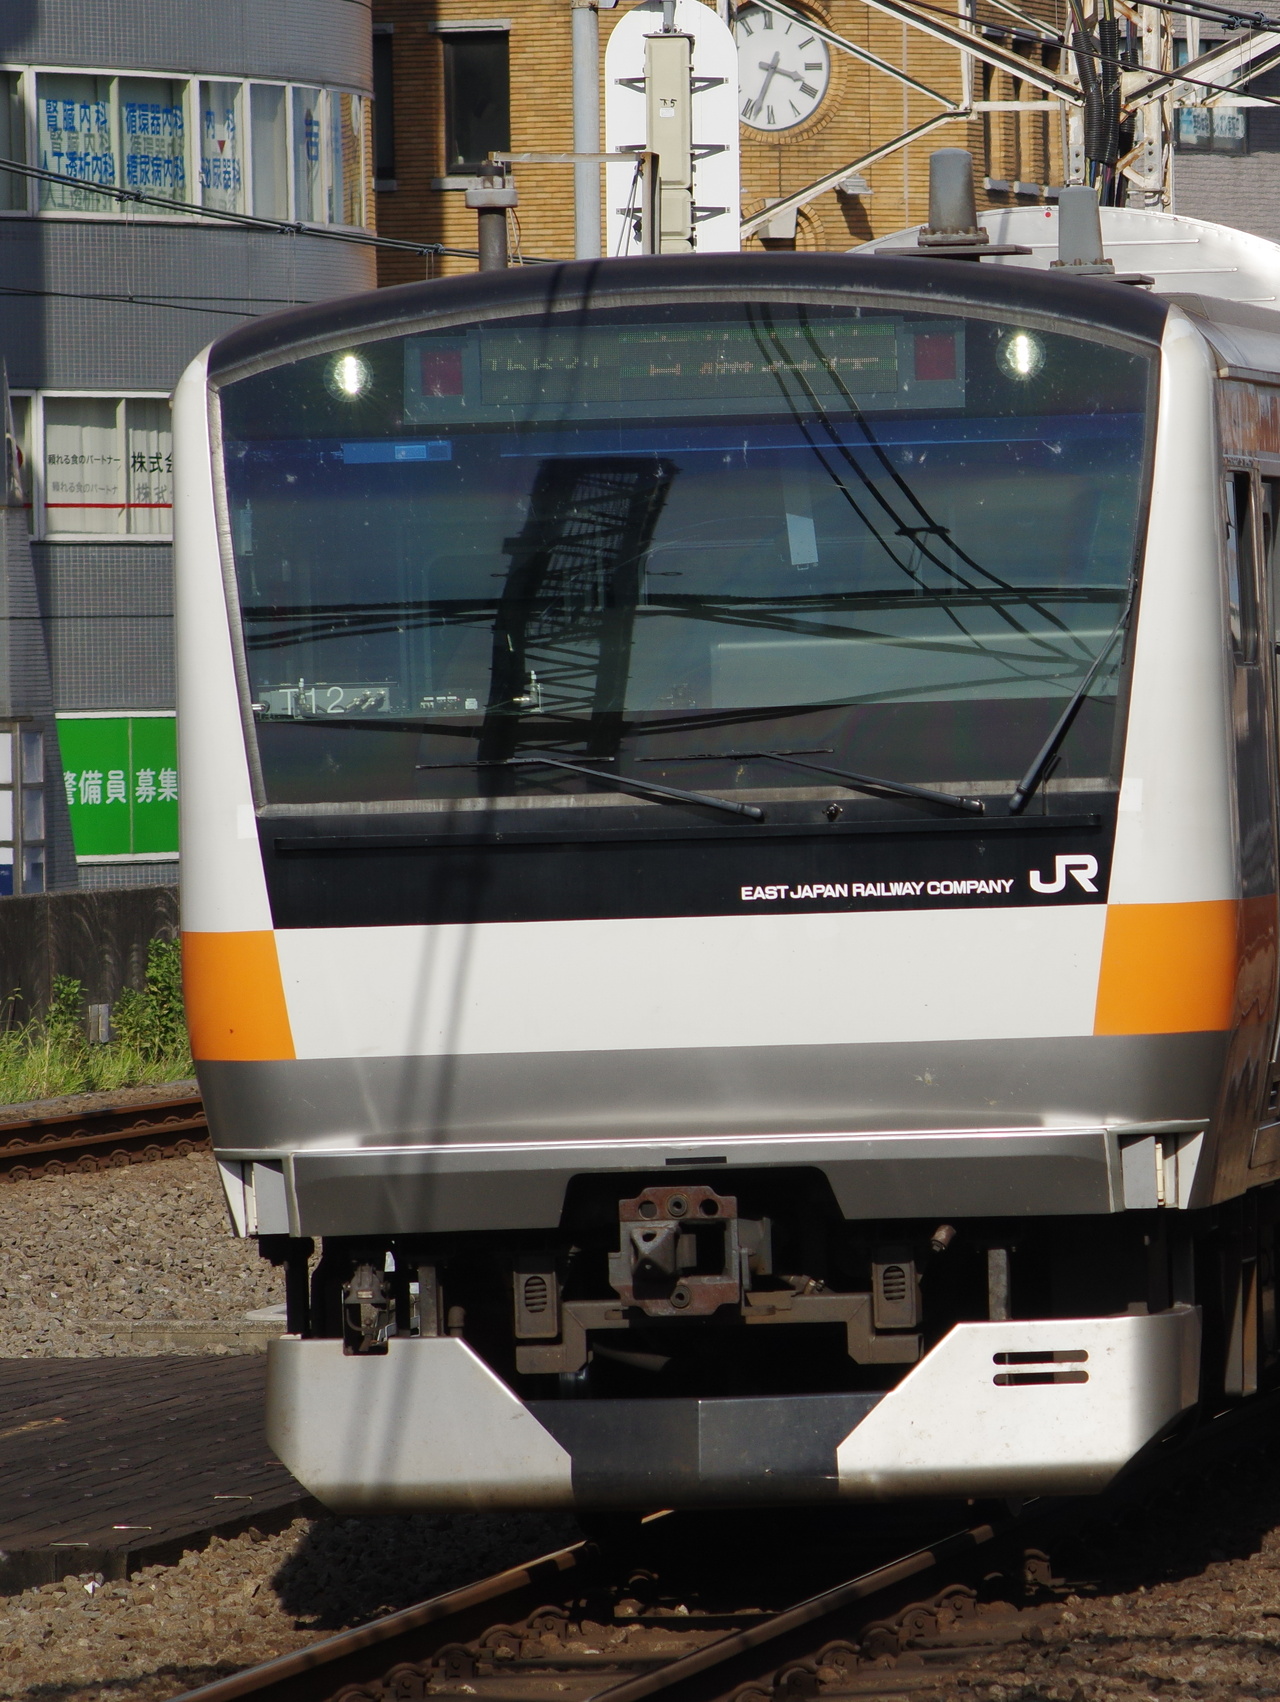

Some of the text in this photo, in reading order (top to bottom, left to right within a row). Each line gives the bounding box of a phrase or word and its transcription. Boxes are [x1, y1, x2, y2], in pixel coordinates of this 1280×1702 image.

[126, 103, 184, 136] 循環器内科
[126, 154, 185, 187] 糖尿病内科
[741, 879, 1015, 900] EAST JAPAN RAILWAY COMPANY
[1029, 854, 1099, 893] JR
